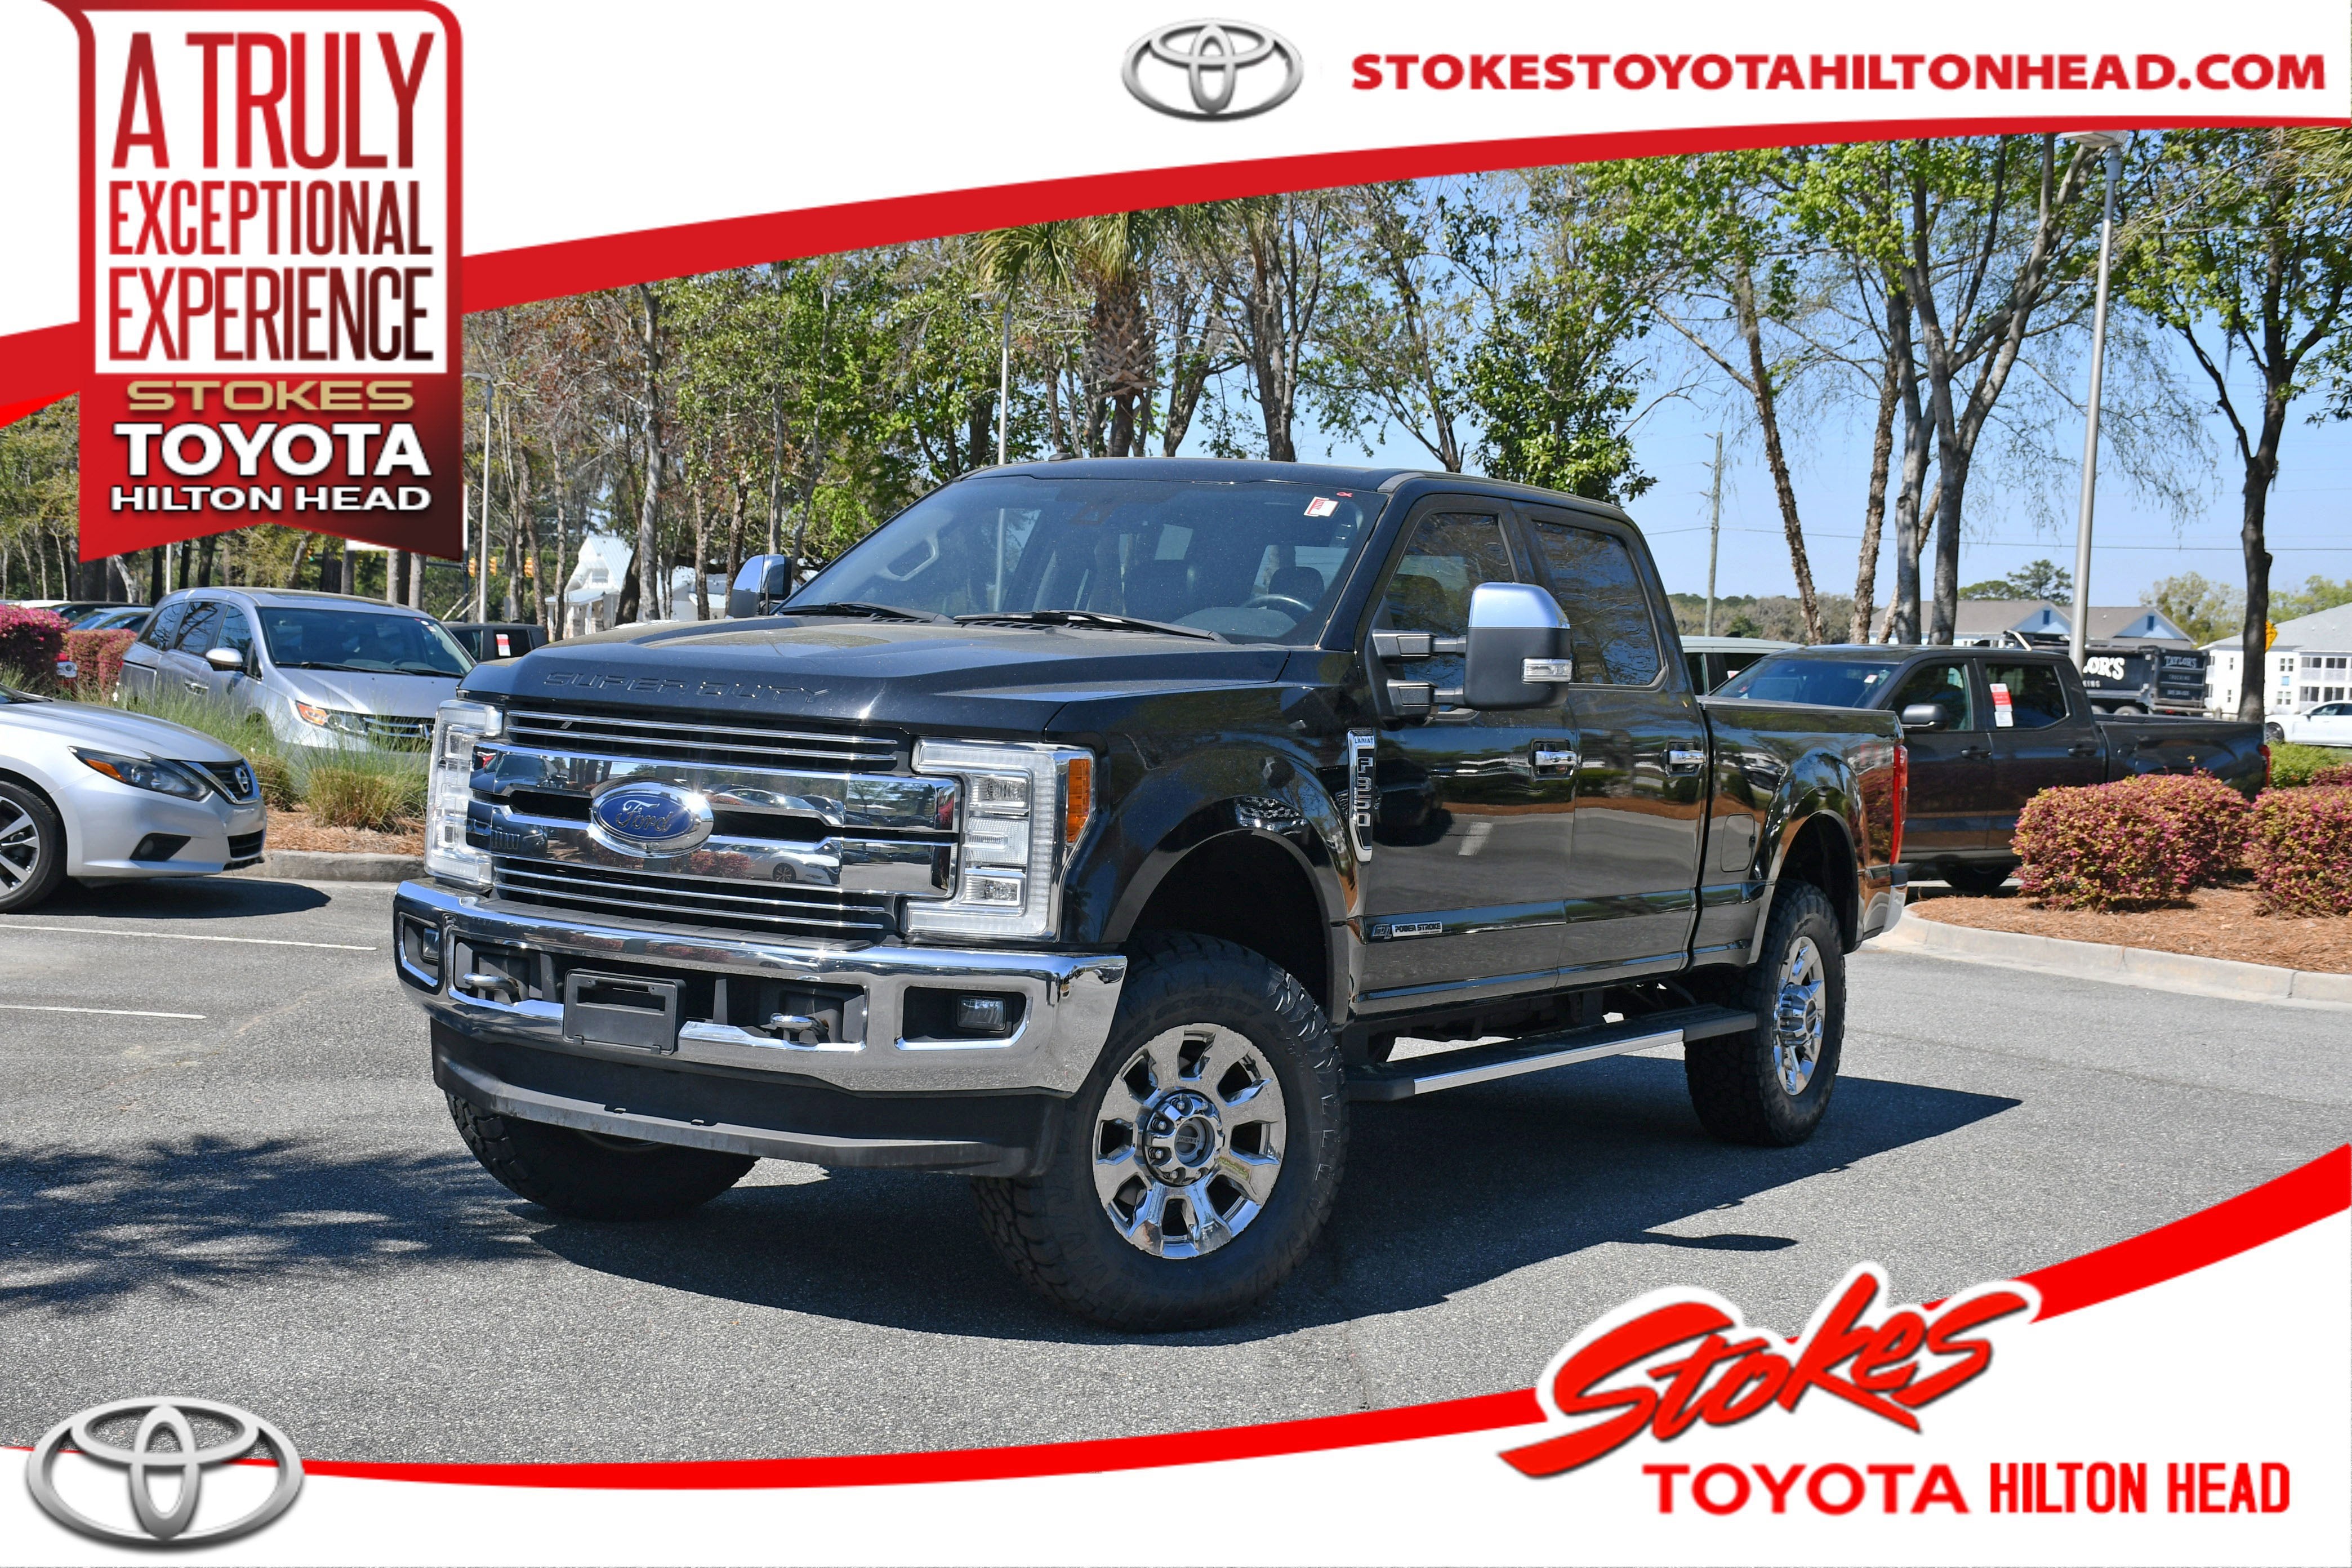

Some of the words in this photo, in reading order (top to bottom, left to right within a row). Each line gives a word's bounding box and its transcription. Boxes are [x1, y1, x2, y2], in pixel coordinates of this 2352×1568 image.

[2083, 656, 2125, 680] OR'S
[544, 672, 689, 692] SUPER
[696, 680, 832, 704] DUTY
[1354, 736, 1374, 744] LARIAT
[616, 799, 674, 832] Ford
[1395, 924, 1416, 933] POWER
[1417, 923, 1441, 931] STROKE
